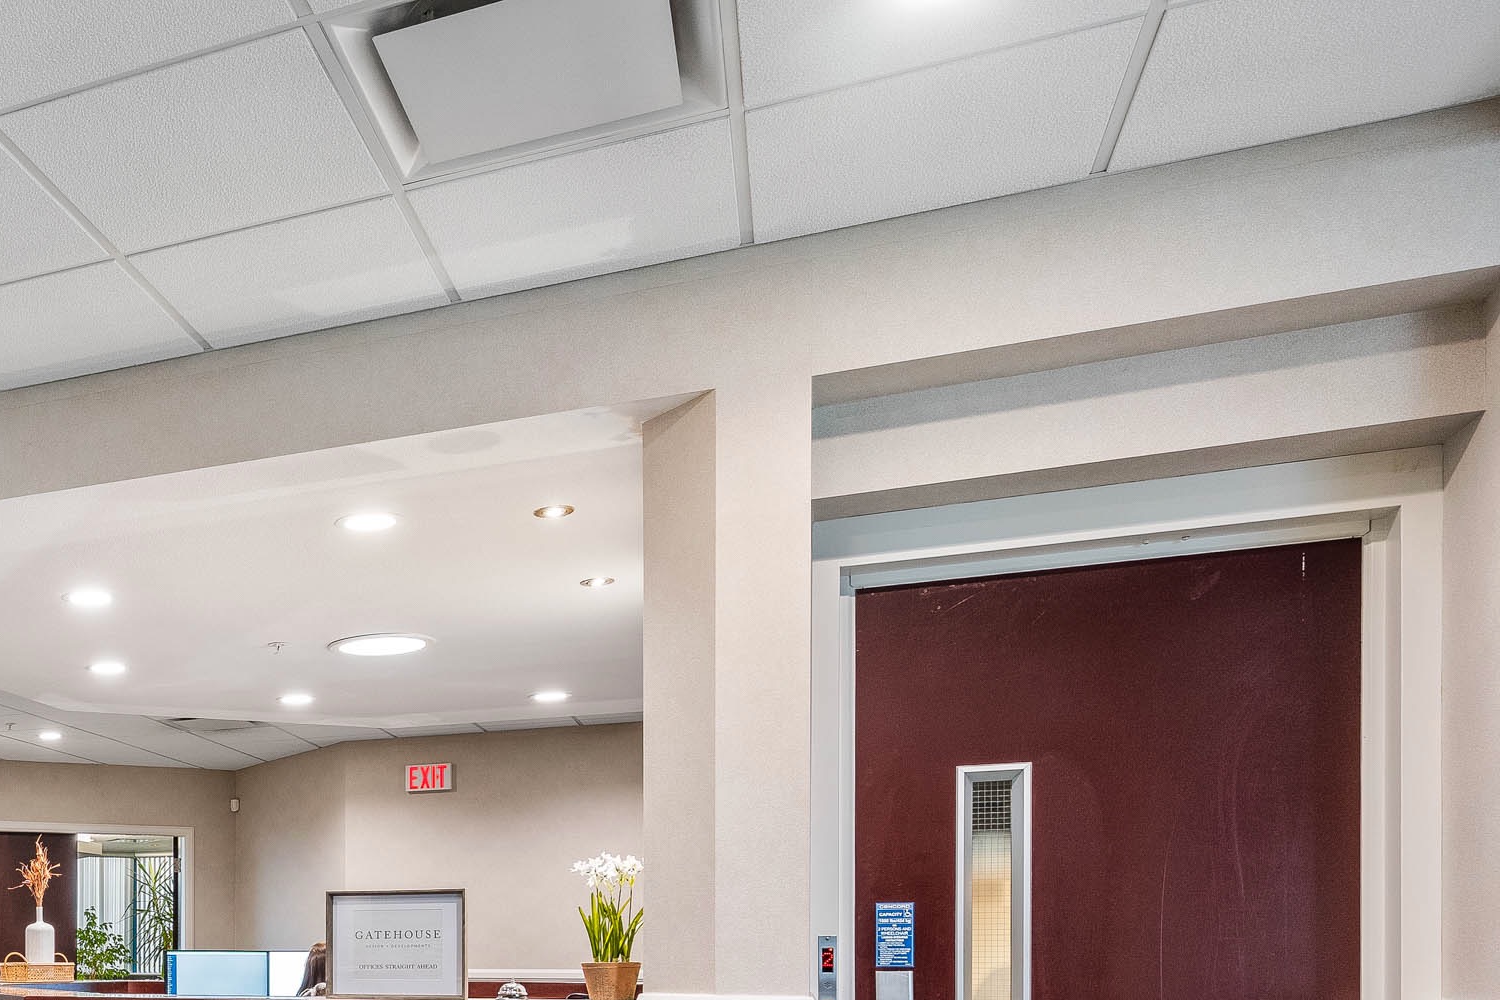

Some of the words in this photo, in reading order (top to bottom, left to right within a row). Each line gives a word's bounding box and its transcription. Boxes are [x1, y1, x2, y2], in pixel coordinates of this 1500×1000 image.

[409, 765, 447, 789] EXIT
[355, 929, 441, 940] GATEHOUSE
[821, 952, 834, 967] 2
